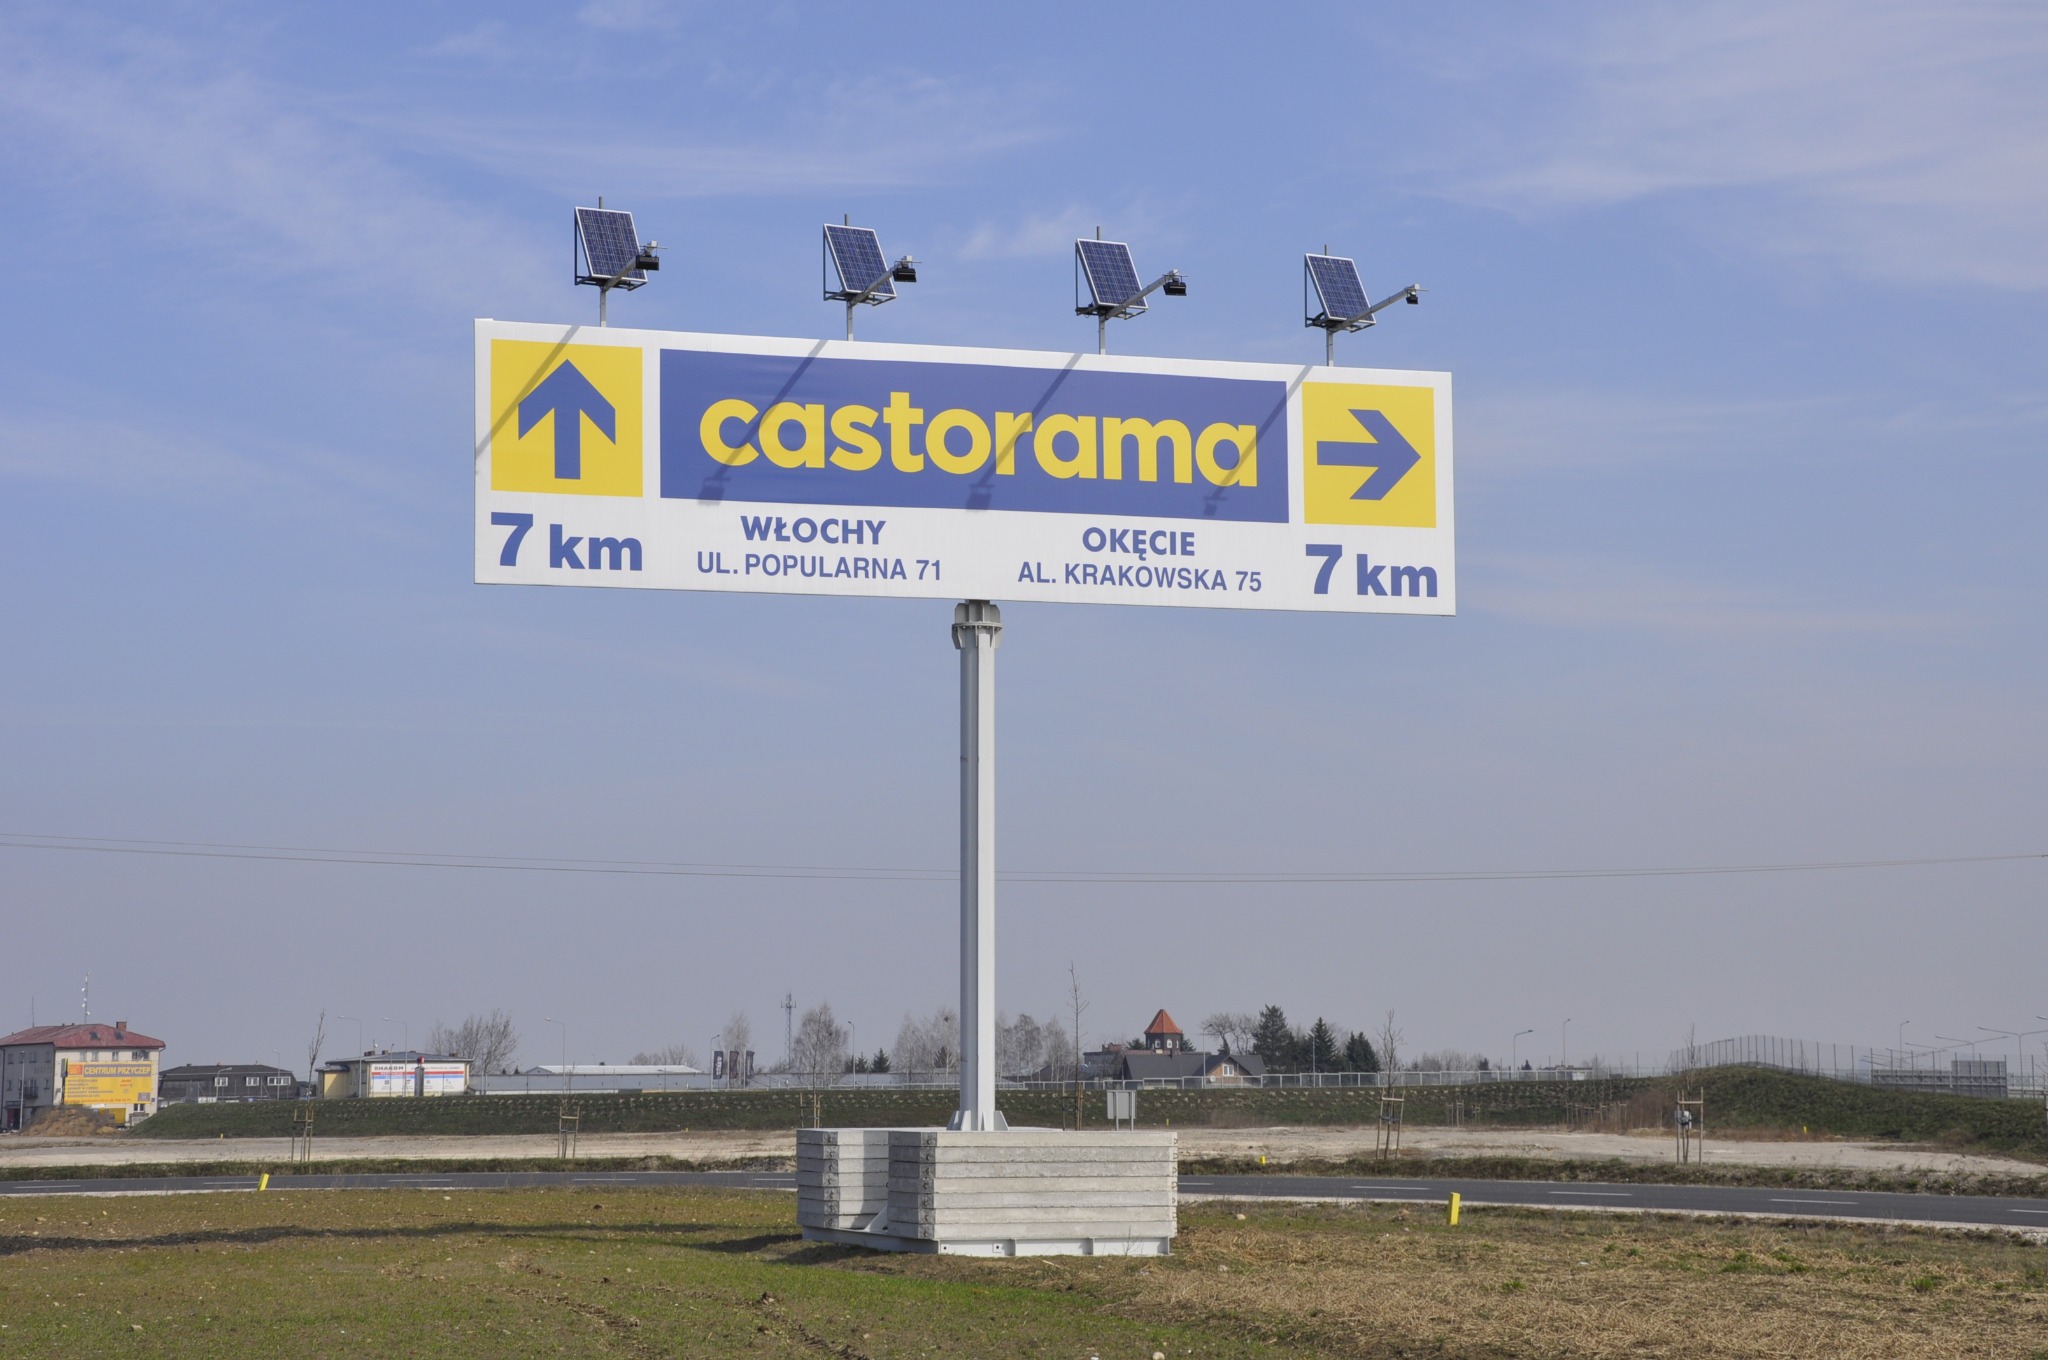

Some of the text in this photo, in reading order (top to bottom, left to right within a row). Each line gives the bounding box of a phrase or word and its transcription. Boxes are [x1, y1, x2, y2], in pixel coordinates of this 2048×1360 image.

[700, 391, 1258, 487] castorama
[491, 511, 643, 571] 7 km
[740, 515, 886, 545] WŁOCHY
[1082, 526, 1195, 560] OKĘCIE
[697, 551, 941, 581] UL. POPULARNA 71
[1018, 561, 1262, 592] AL. KRAKOWSKA 75
[1305, 543, 1438, 598] 7 km
[85, 1066, 116, 1075] CENTRUM
[118, 1066, 151, 1075] PRZYCZEP
